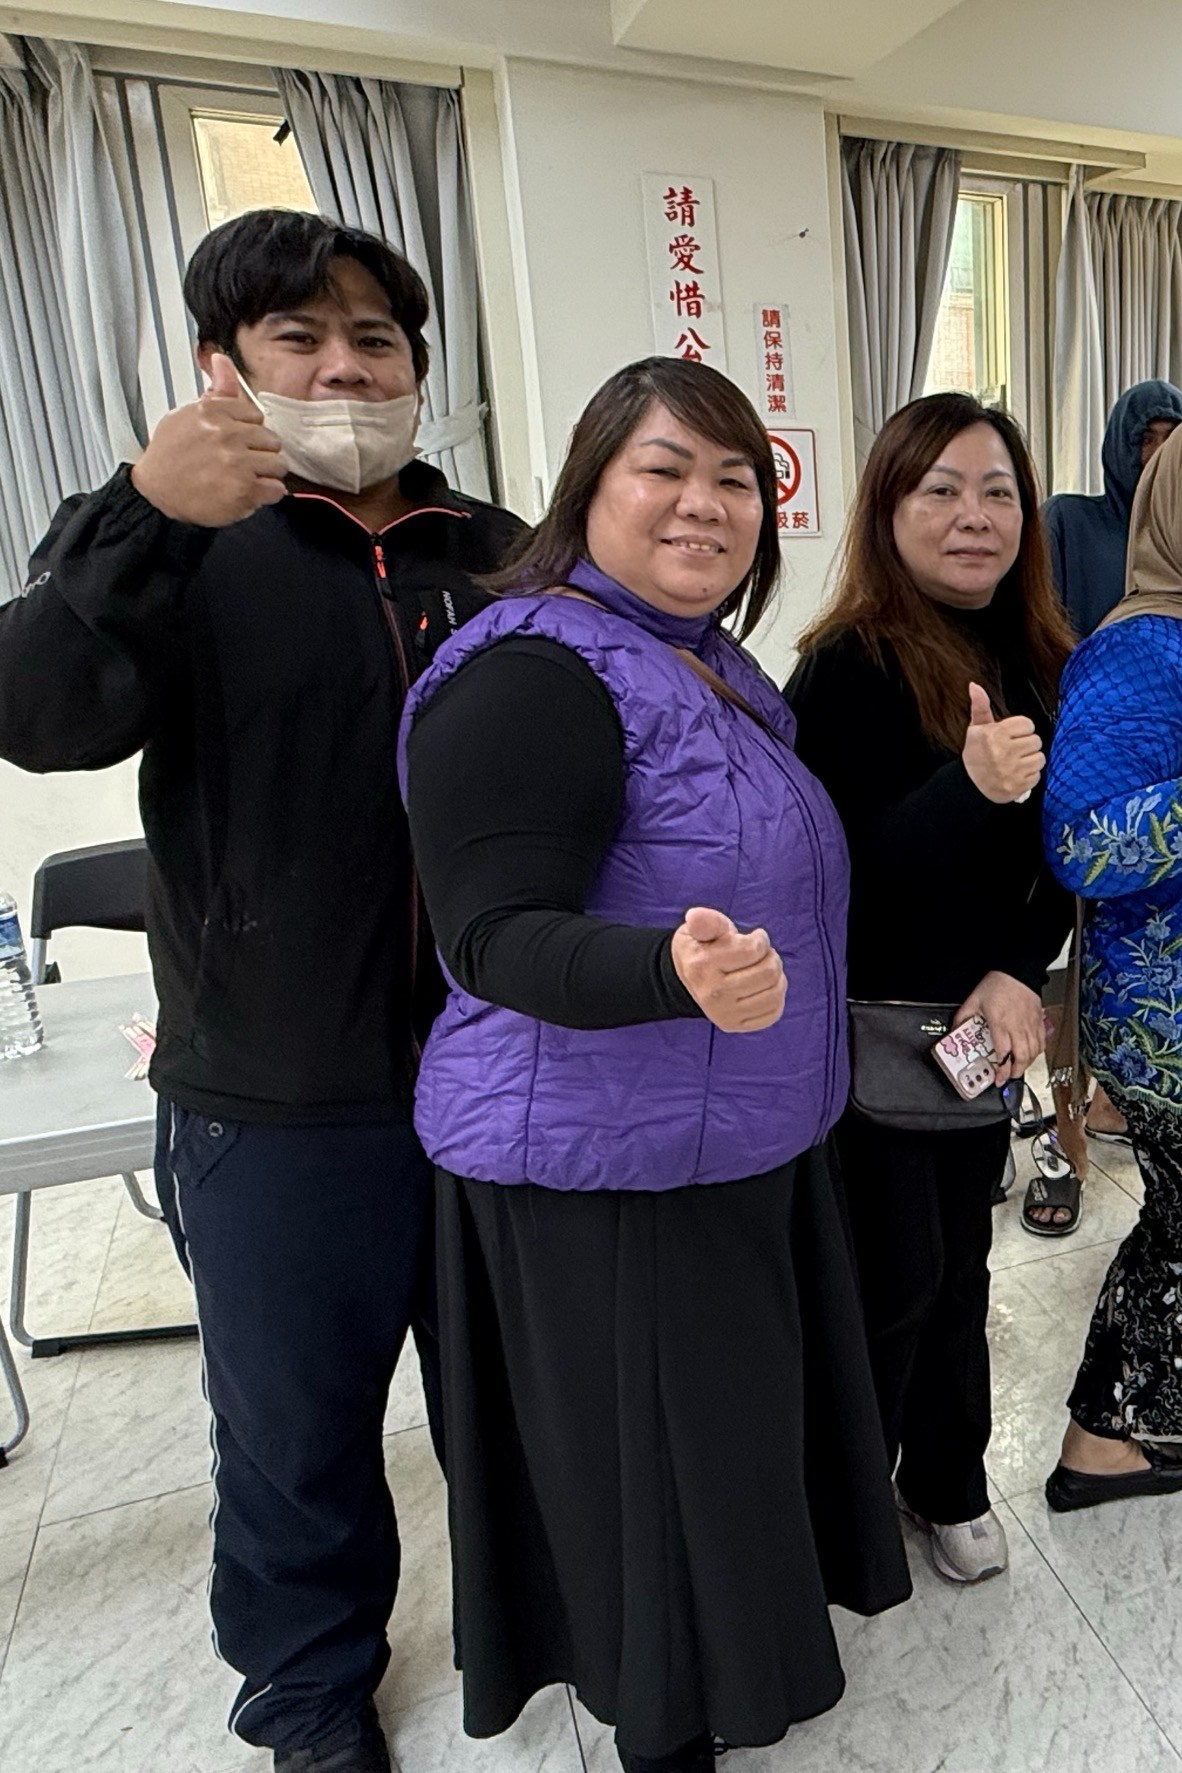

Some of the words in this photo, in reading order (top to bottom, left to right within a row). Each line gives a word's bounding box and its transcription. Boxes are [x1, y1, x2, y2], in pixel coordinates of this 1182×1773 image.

[663, 186, 711, 362] 請愛惜公
[761, 309, 787, 413] 請保持清潔
